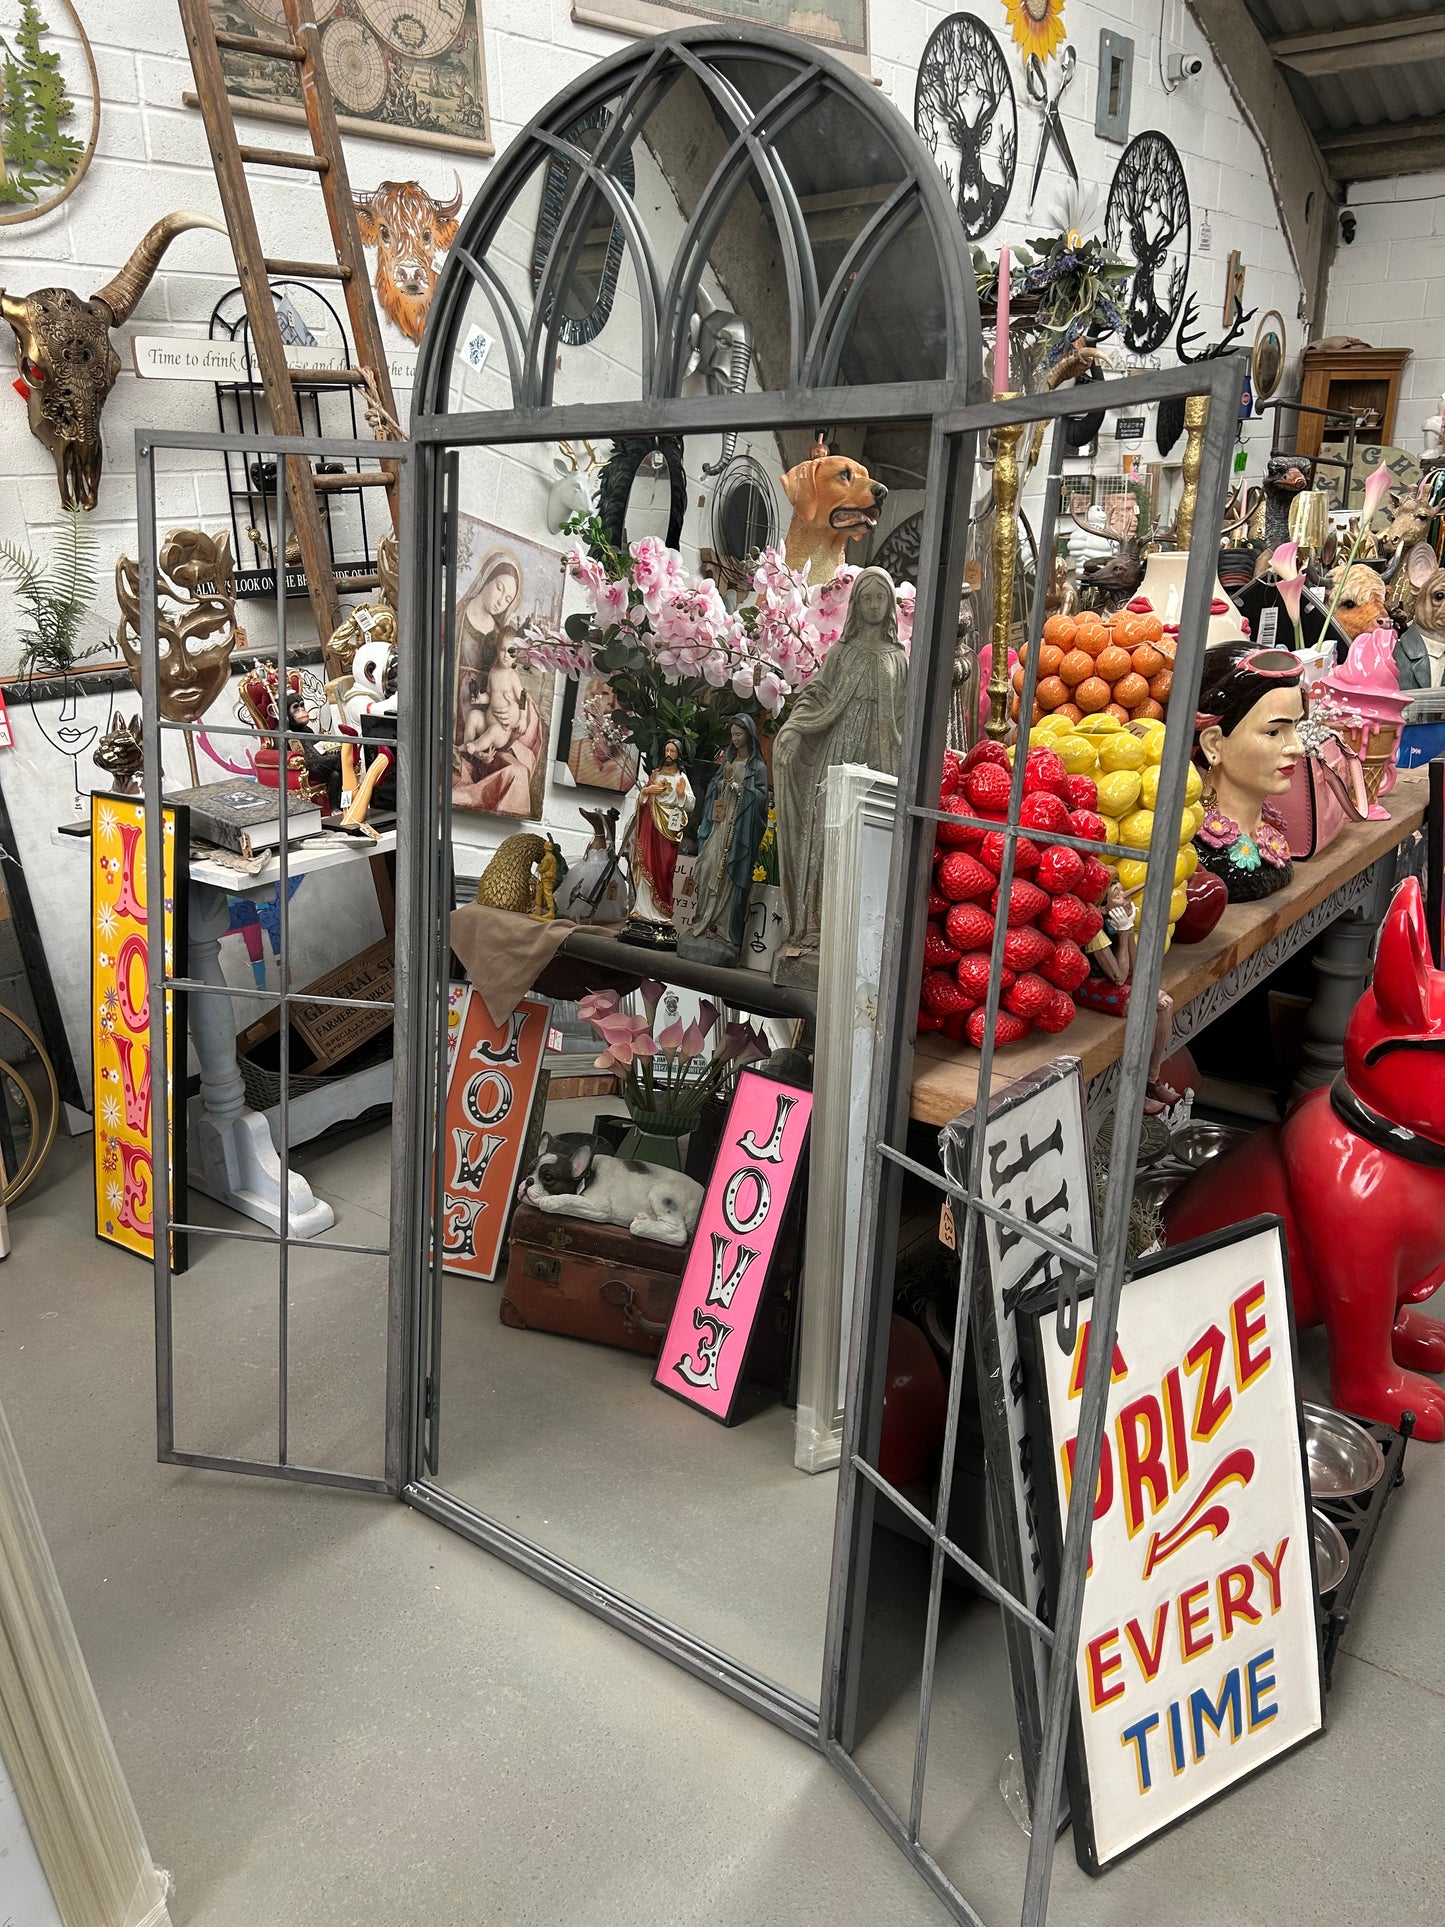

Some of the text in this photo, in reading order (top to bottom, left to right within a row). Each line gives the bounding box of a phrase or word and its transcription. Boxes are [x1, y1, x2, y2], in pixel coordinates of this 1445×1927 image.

[148, 348, 181, 366] Time
[186, 353, 199, 367] to
[202, 350, 241, 372] drink
[235, 577, 261, 592] LOOK
[303, 970, 377, 1022] GEERAL
[1085, 1536, 1290, 1714] EVERY
[1120, 1648, 1279, 1796] TIME
